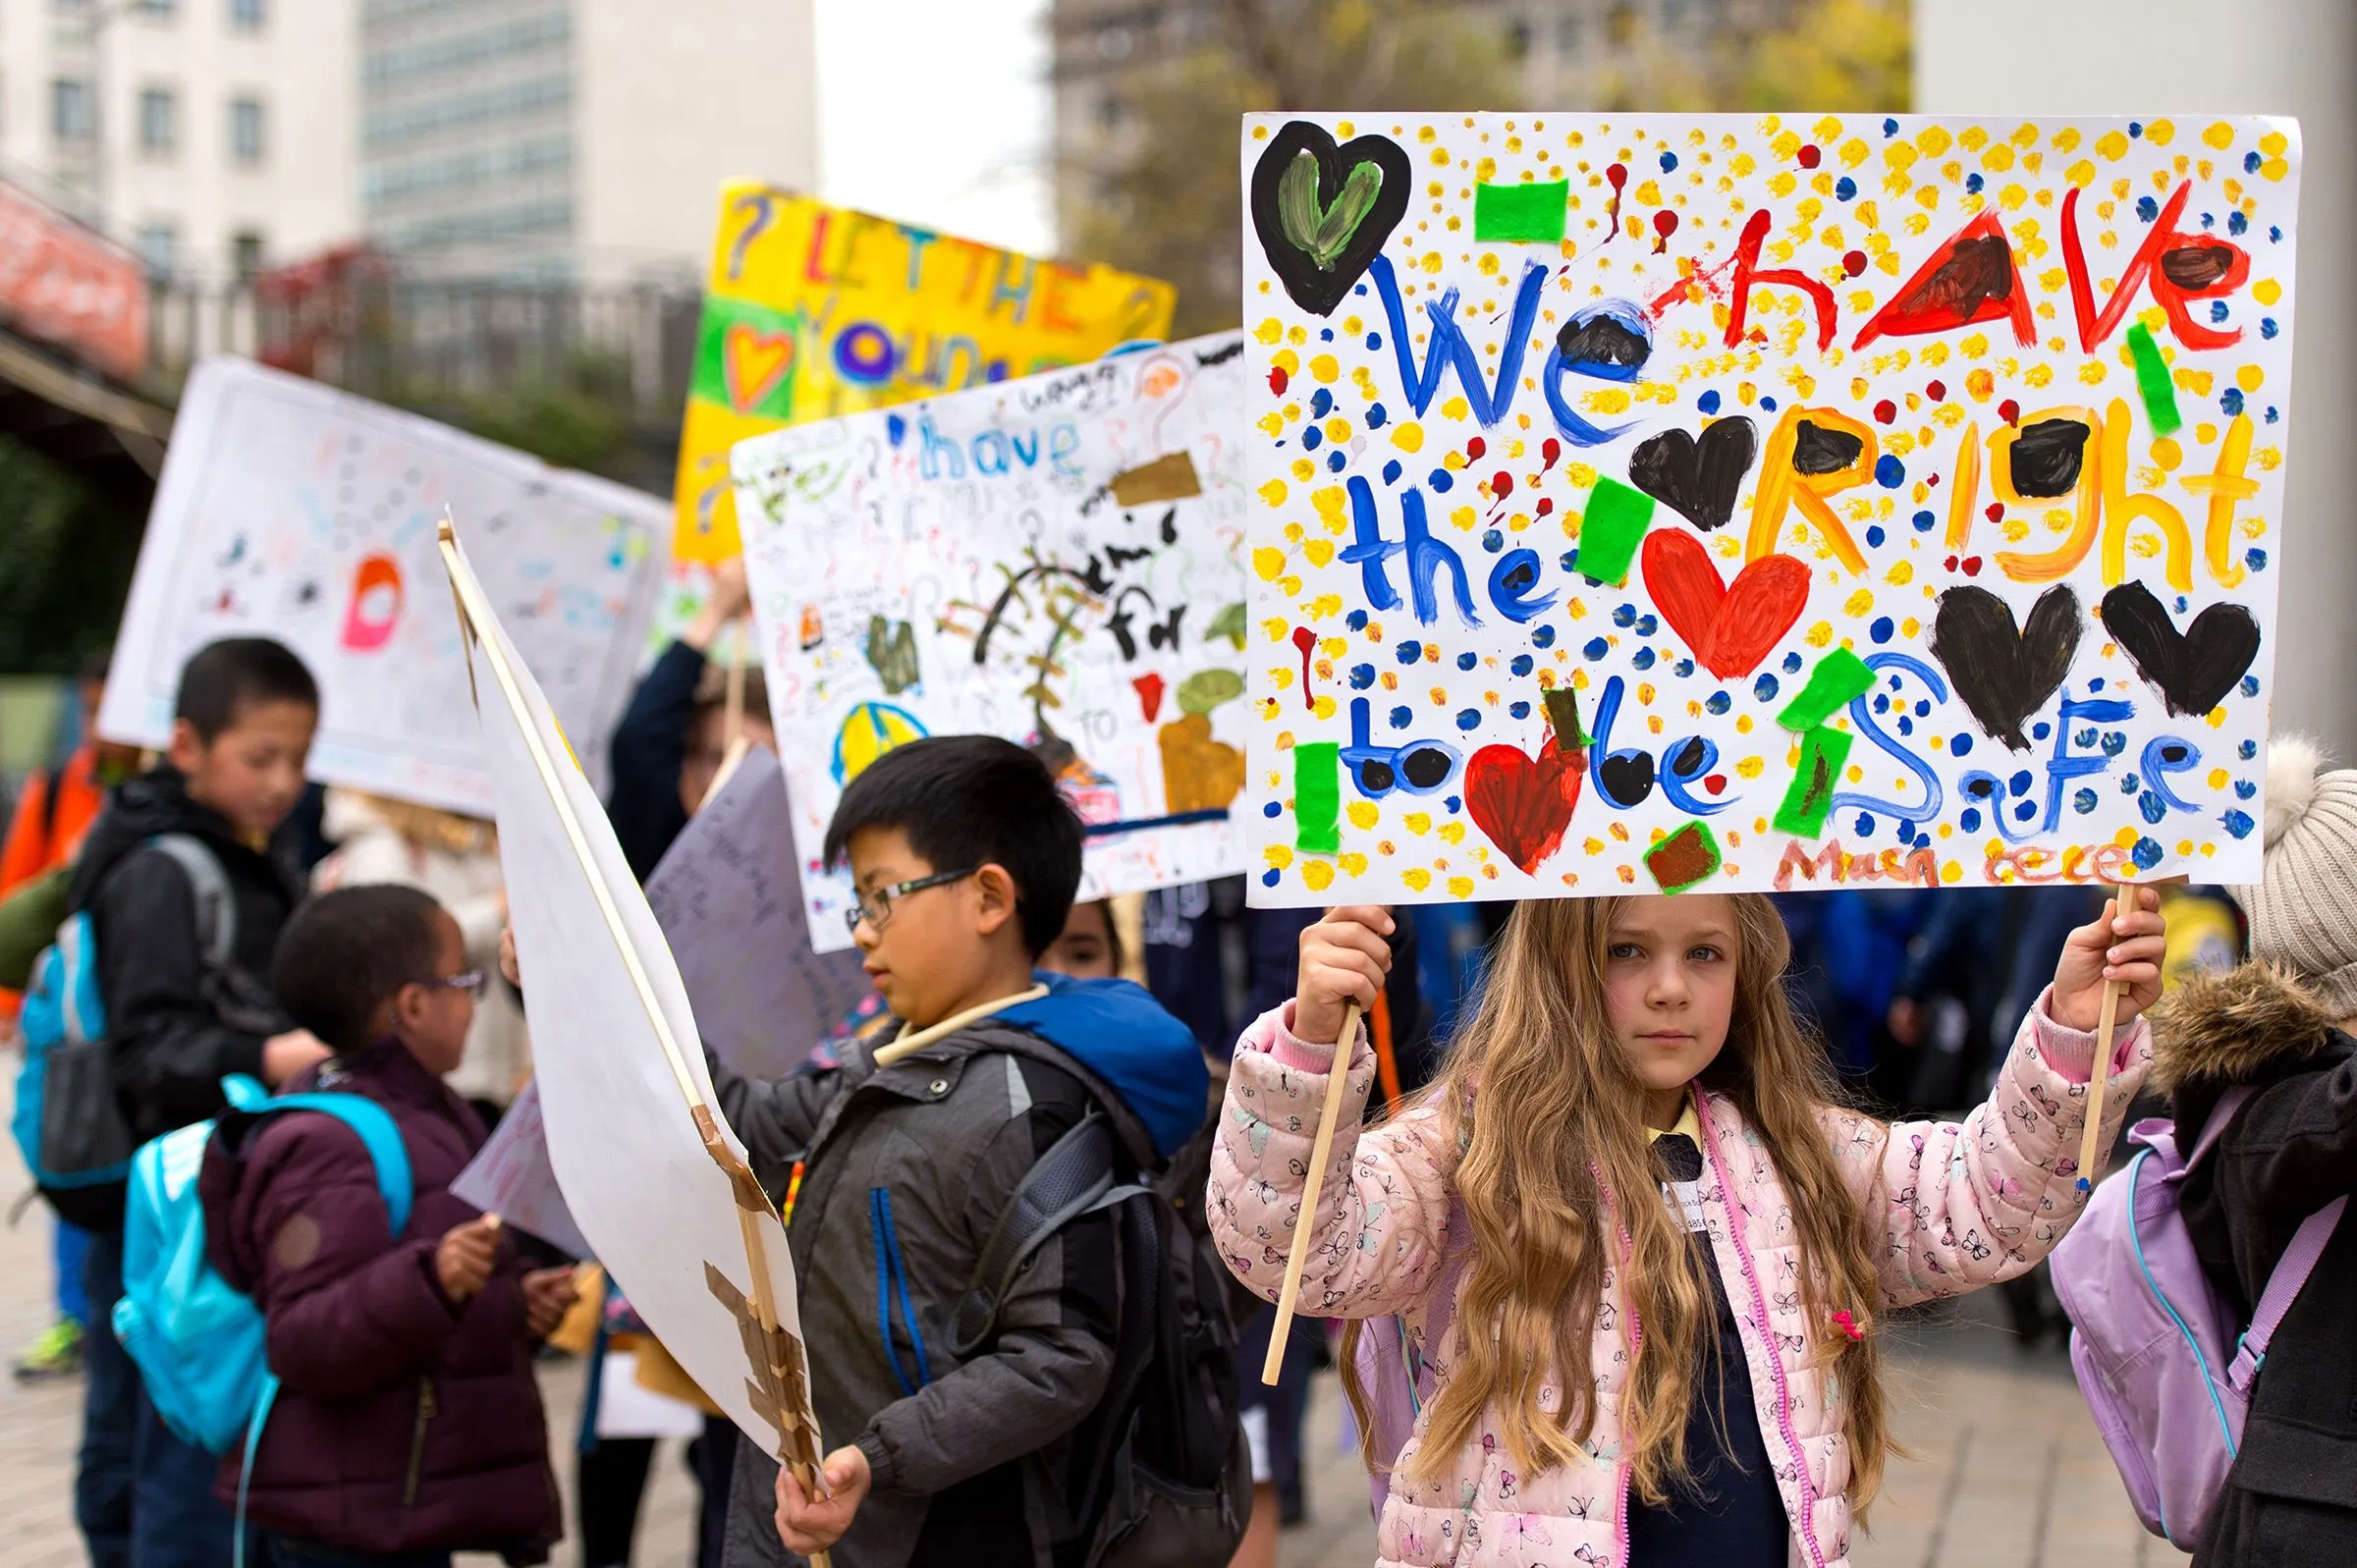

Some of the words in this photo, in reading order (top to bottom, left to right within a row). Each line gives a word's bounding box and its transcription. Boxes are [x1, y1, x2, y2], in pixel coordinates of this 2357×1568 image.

[1369, 251, 1653, 448] We
[915, 411, 1083, 479] have
[1339, 474, 1561, 629] the
[1339, 696, 1463, 800] to
[1589, 675, 1743, 817] be
